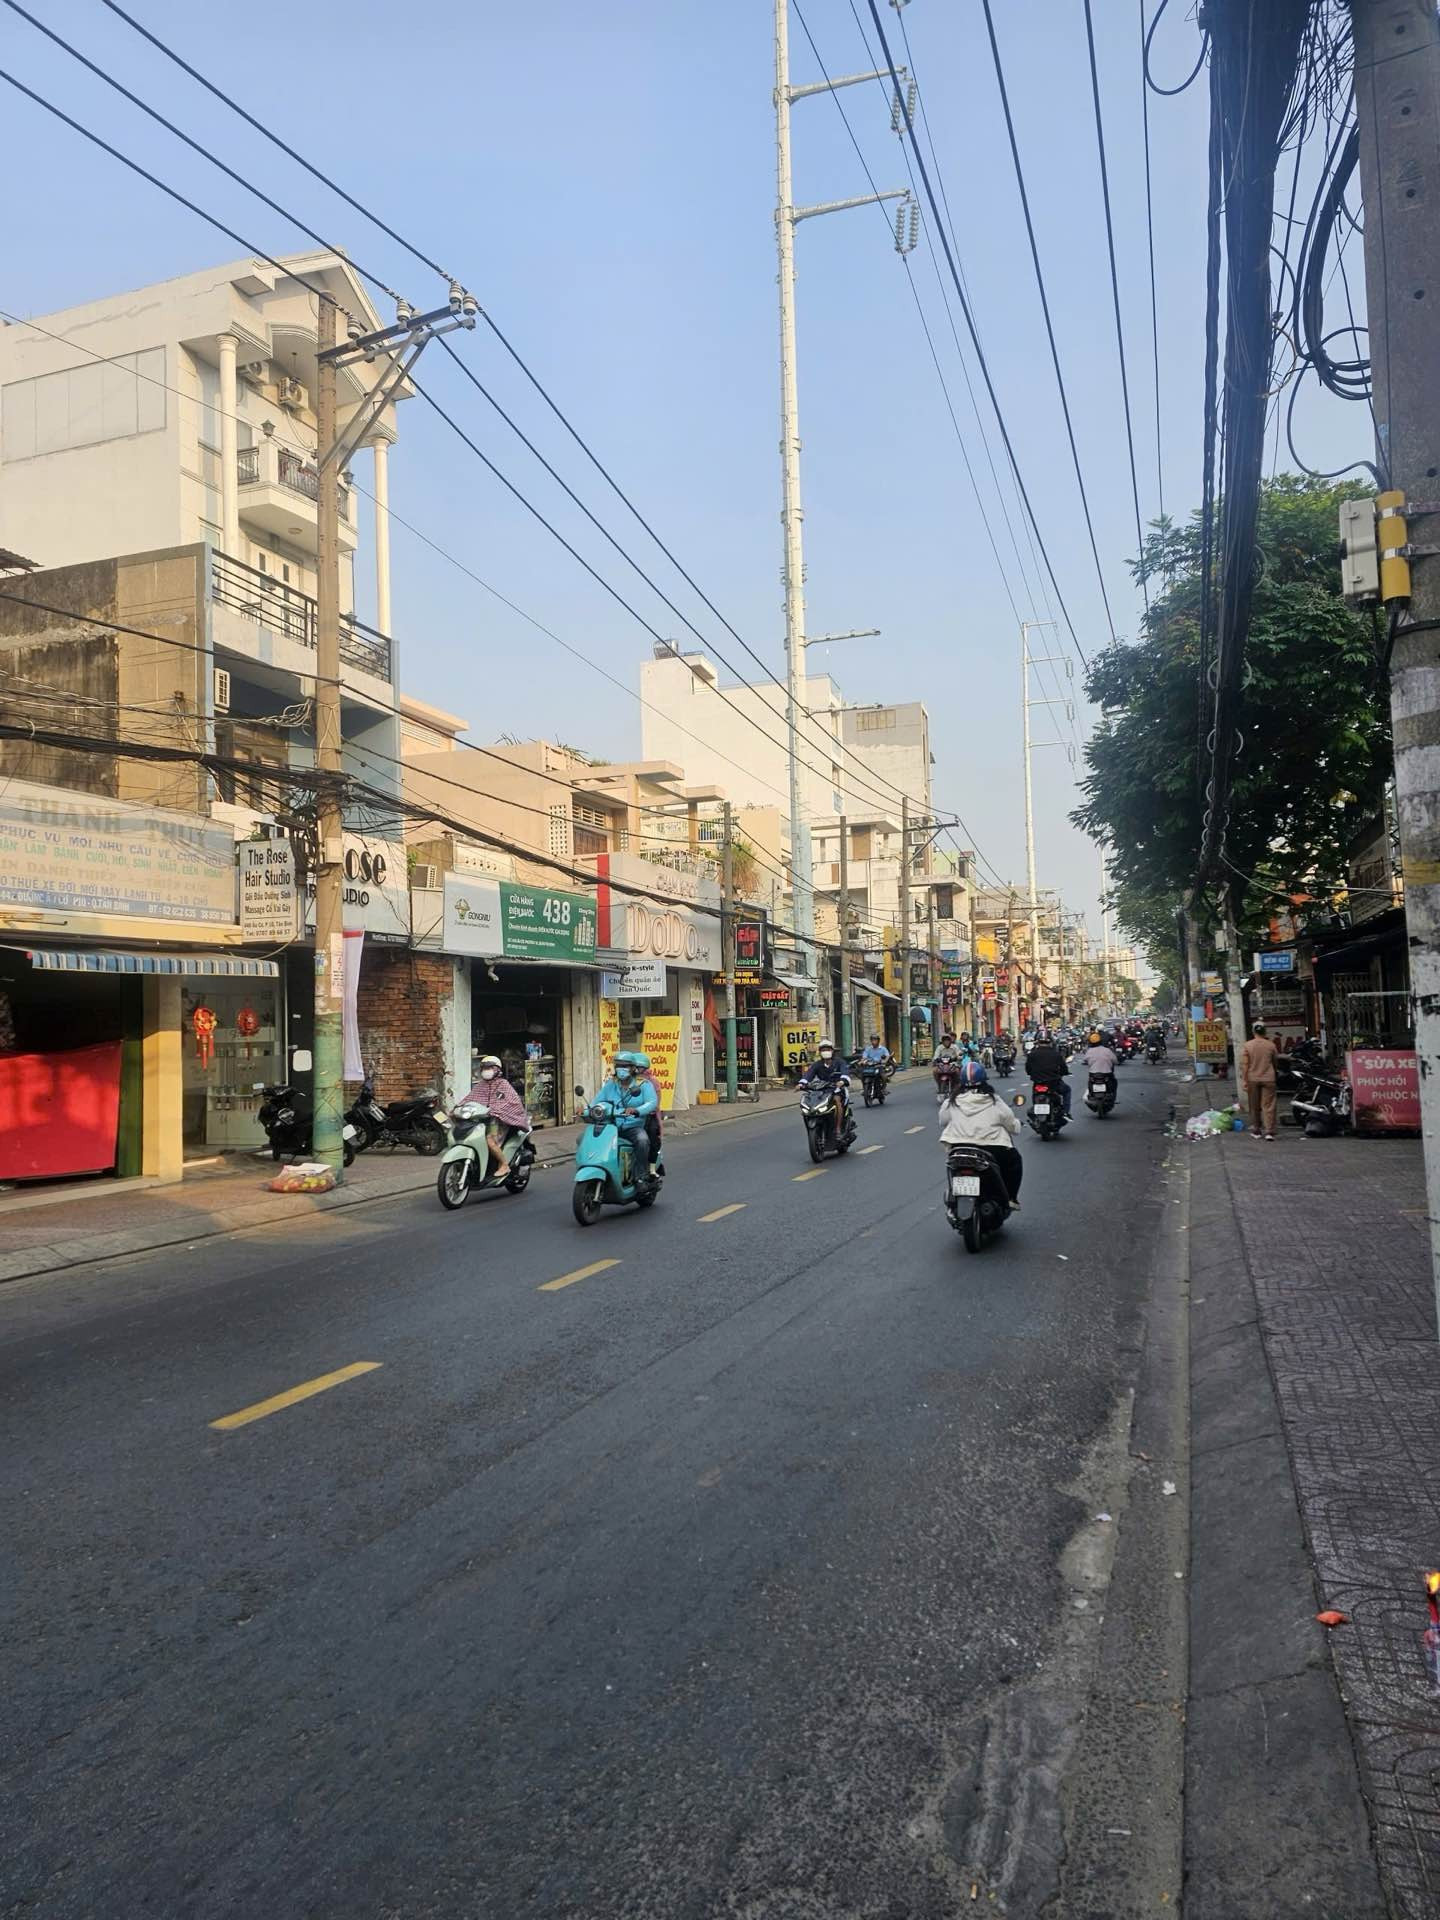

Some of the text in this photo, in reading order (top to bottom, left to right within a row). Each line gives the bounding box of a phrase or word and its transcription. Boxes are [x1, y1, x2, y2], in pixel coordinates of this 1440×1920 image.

[248, 848, 288, 867] The Rose
[43, 879, 55, 891] XE
[245, 868, 291, 888] Hair Studio
[245, 905, 265, 916] Massage
[510, 893, 520, 904] CỬA
[520, 896, 534, 906] HÀNG
[543, 898, 571, 925] 438
[645, 1032, 672, 1041] THANH
[787, 1026, 817, 1046] GIẶT
[1364, 1055, 1417, 1070] SỬA XE
[1357, 1076, 1386, 1088] PHỤC
